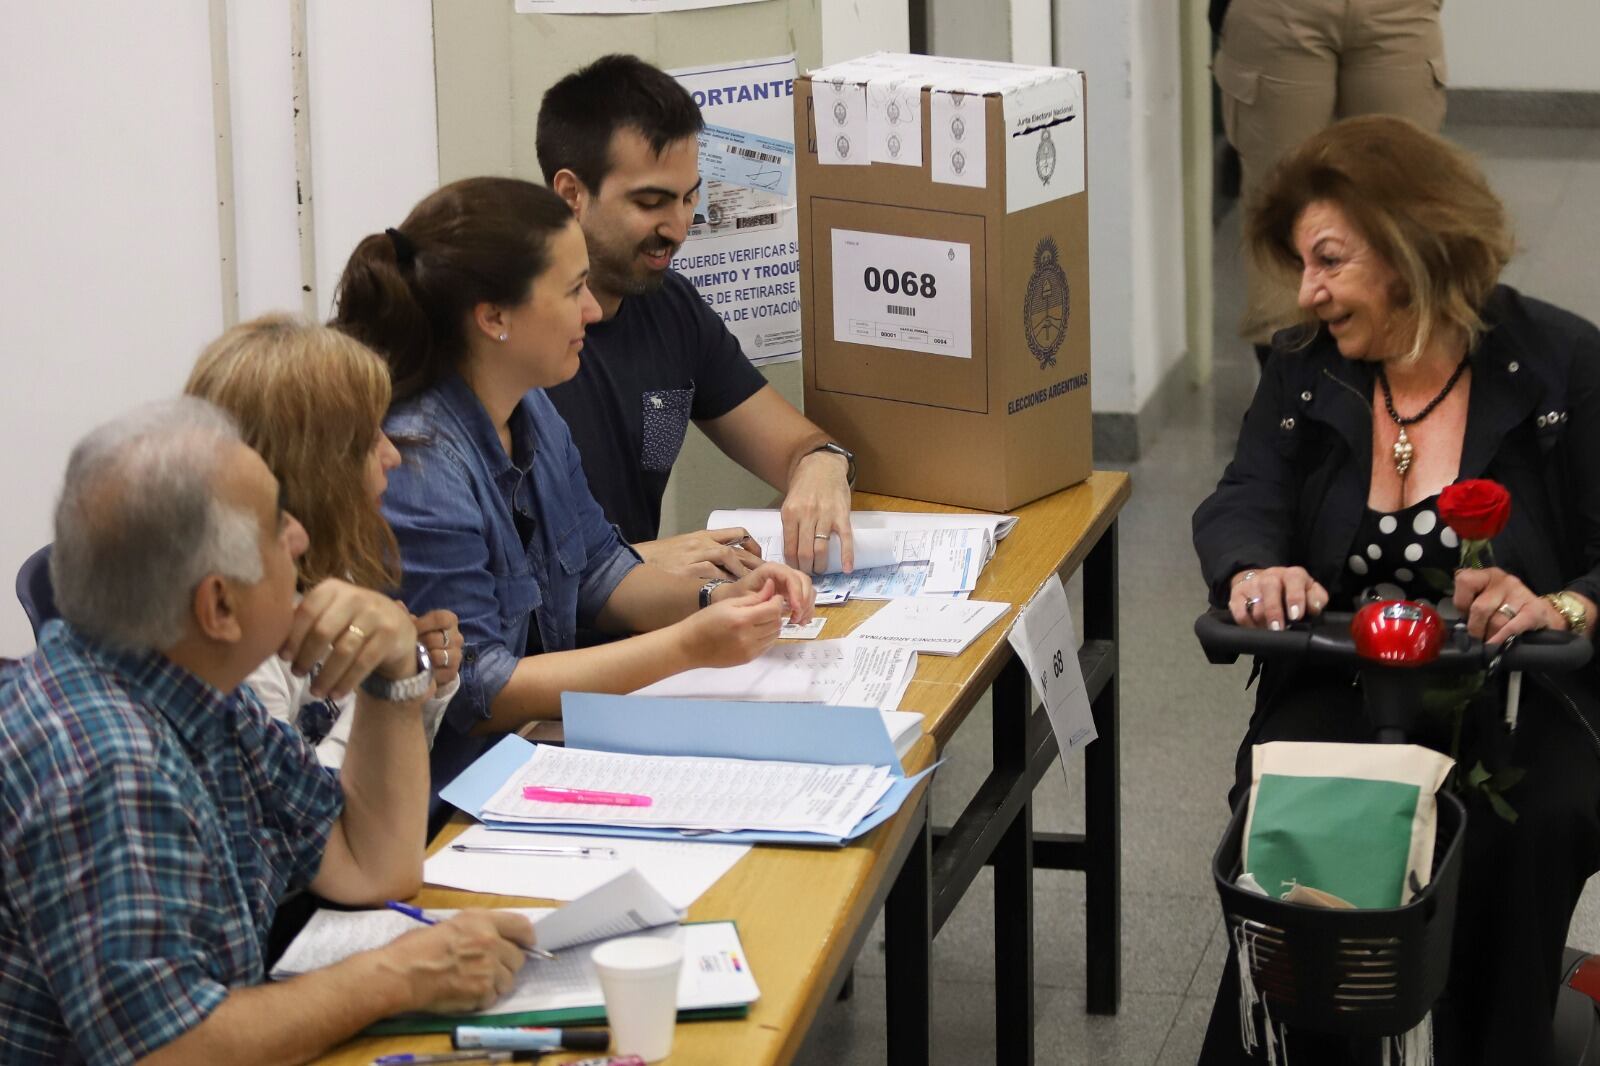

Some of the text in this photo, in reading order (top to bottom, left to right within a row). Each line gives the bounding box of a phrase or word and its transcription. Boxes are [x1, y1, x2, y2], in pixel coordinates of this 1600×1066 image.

[1017, 117, 1031, 127] Junta
[1031, 109, 1053, 123] Electoral
[729, 243, 786, 263] VERIFICAR
[690, 270, 738, 288] MENTO
[742, 268, 750, 281] Y
[864, 266, 937, 299] 0068
[717, 291, 732, 304] DE
[735, 281, 796, 301] RETIRARSE
[733, 307, 749, 321] DE
[1007, 373, 1088, 415] ELECCIONES ARGENTINAS
[1053, 649, 1064, 679] 68
